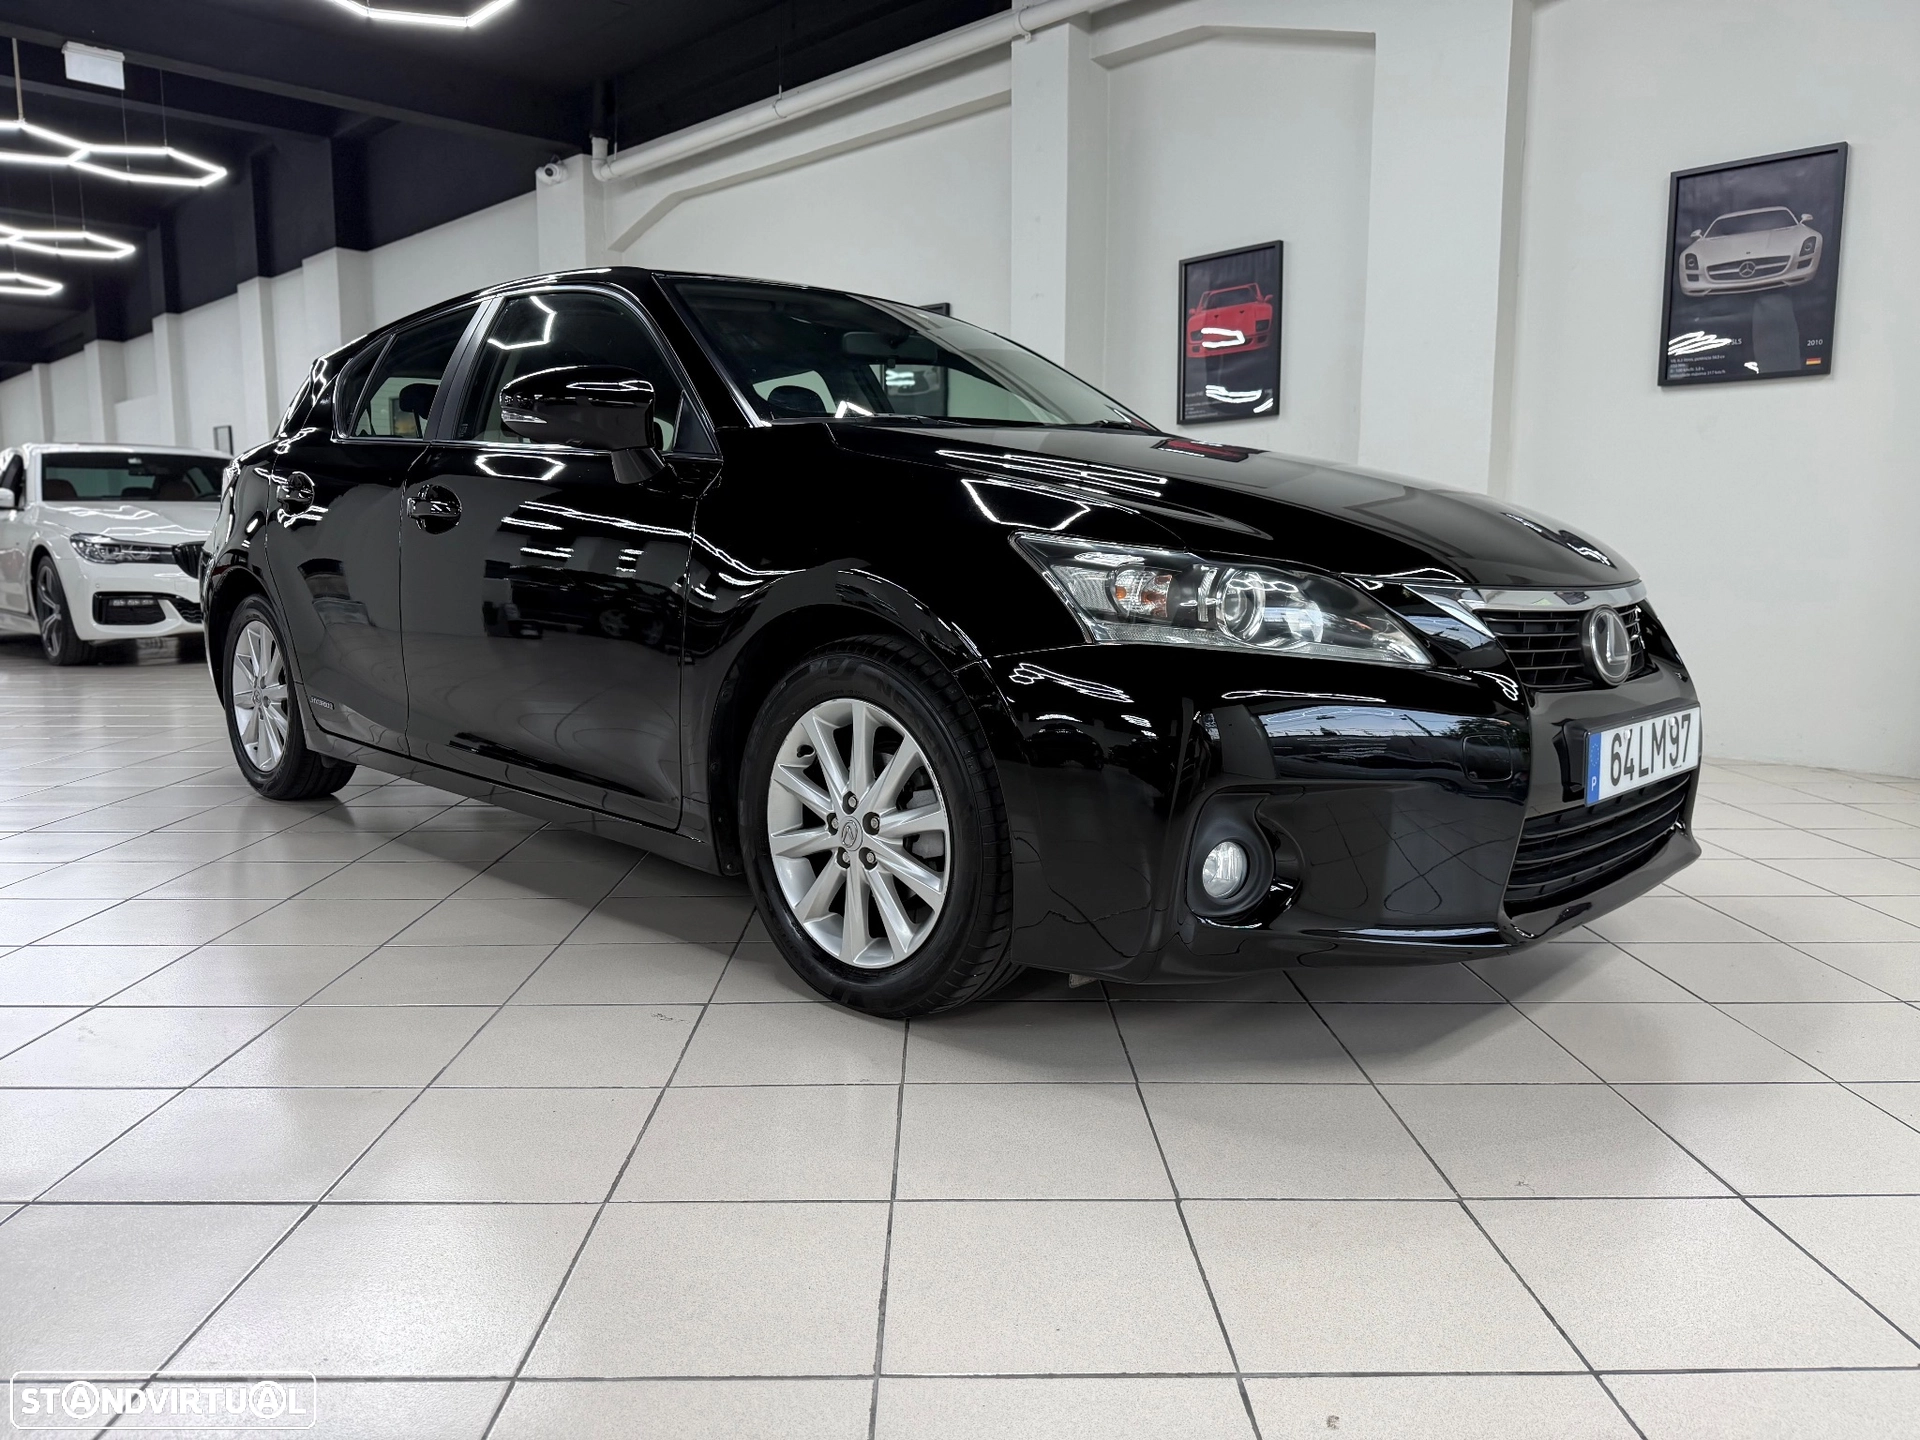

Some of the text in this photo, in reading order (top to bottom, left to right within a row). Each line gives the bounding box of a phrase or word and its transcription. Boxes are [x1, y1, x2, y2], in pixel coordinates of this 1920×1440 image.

[1806, 338, 1824, 347] 2010
[1610, 713, 1691, 787] 64LM97
[1591, 775, 1598, 792] P
